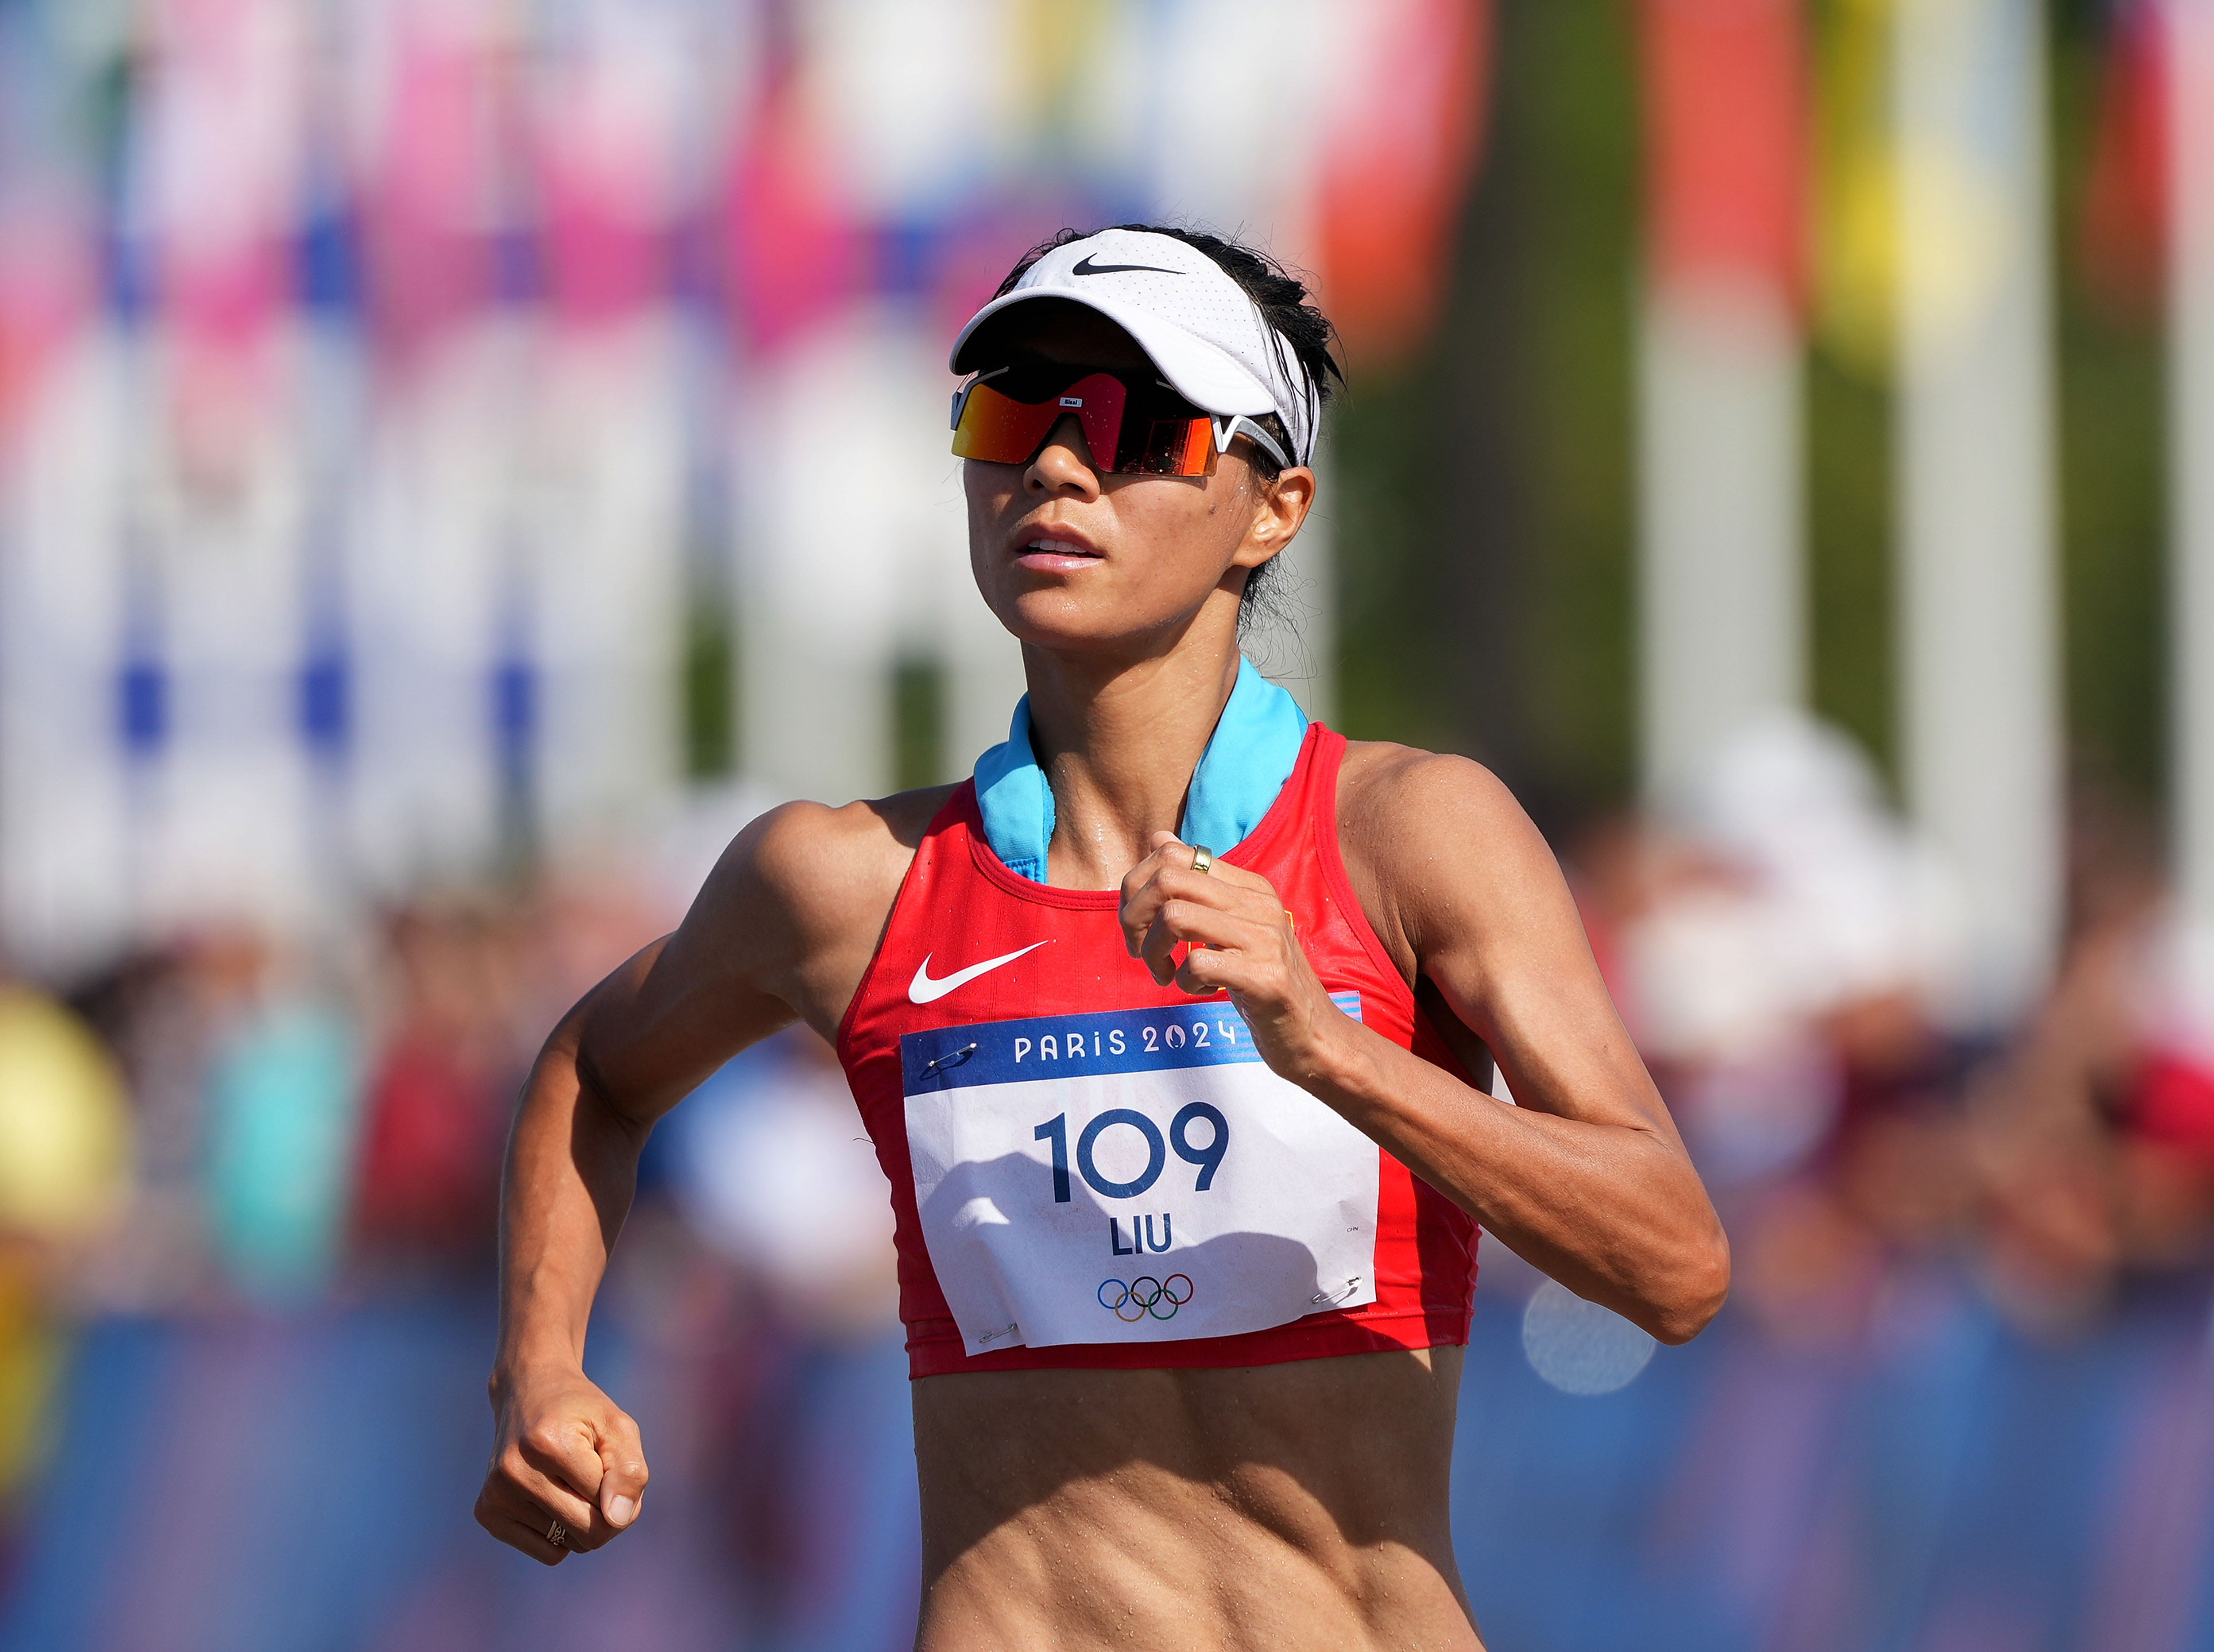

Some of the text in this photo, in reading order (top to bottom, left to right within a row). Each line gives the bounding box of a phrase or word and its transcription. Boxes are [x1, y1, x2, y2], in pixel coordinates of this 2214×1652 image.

[1143, 1020, 1235, 1052] 2024
[1034, 1102, 1229, 1203] 109
[1110, 1213, 1172, 1255] LIU
